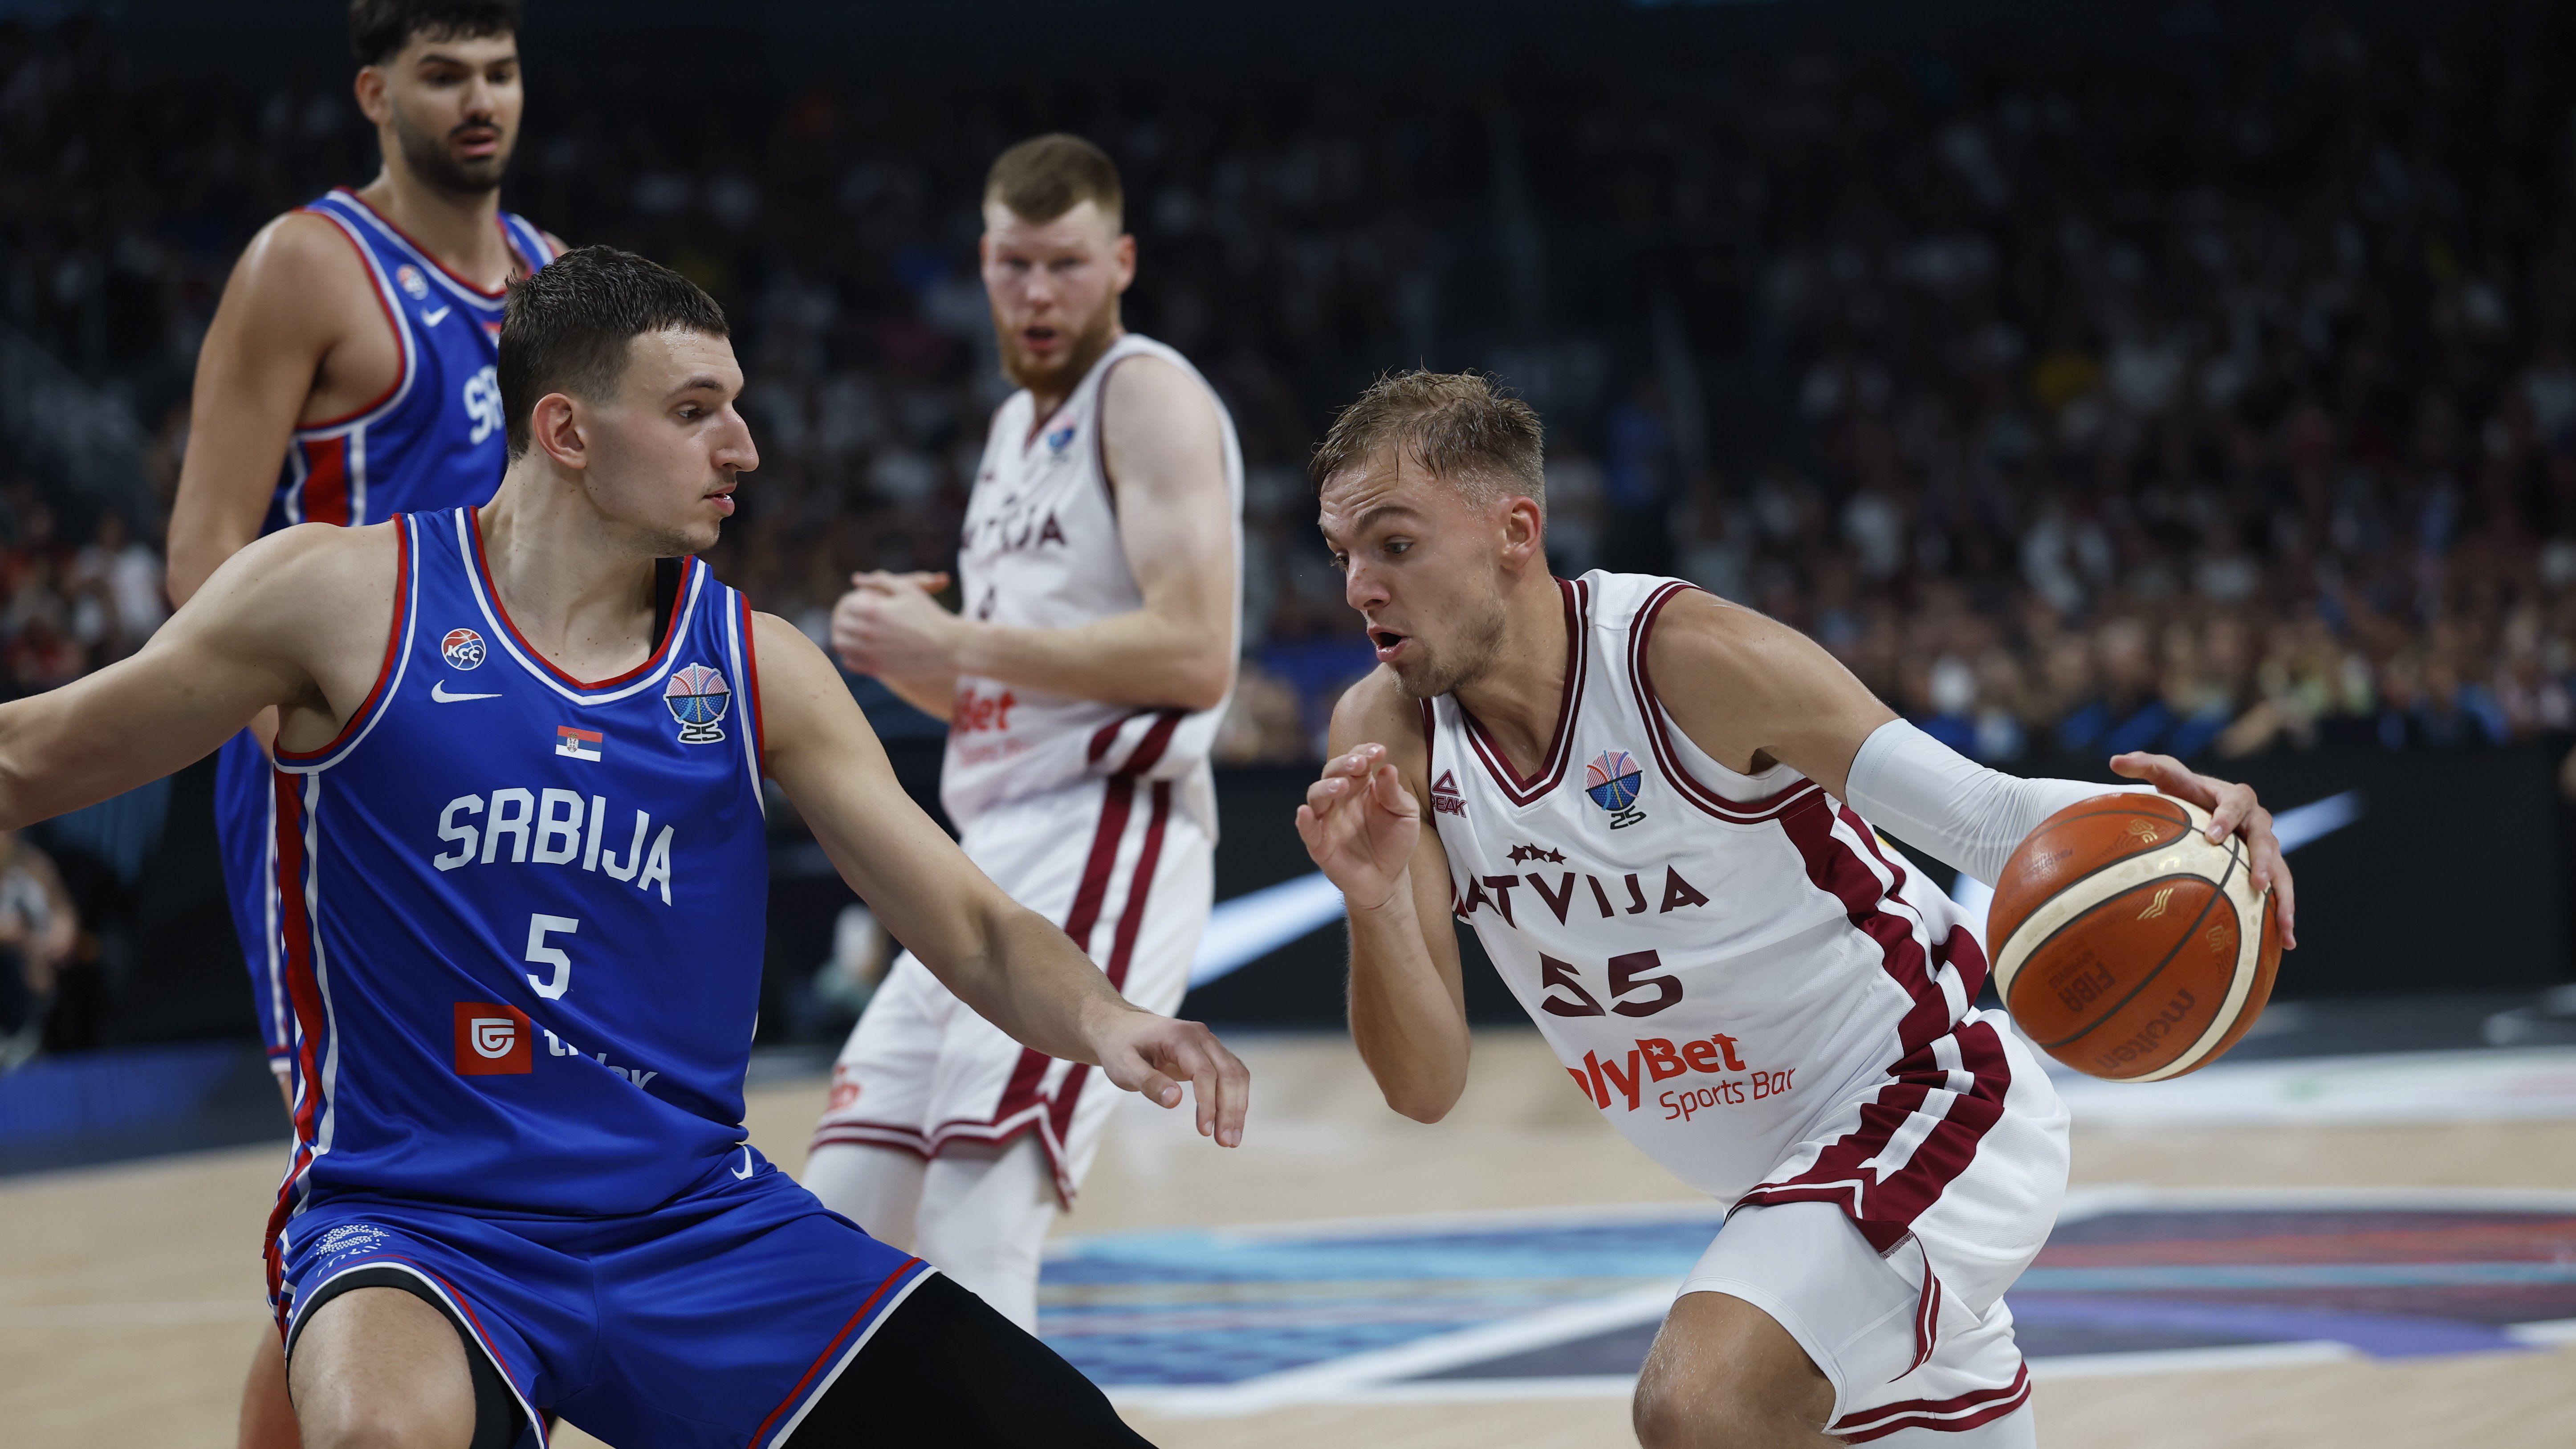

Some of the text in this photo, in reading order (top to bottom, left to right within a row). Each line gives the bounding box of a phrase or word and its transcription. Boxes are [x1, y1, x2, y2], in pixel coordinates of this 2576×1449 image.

[433, 788, 675, 907] SRBIJA
[1465, 864, 1710, 930] ATVIJA
[525, 913, 579, 1001] 5
[1538, 949, 1683, 1018] 55
[2057, 960, 2116, 1013] FIBA
[2095, 987, 2196, 1069] molten
[1659, 1067, 1796, 1122] Sports Bar
